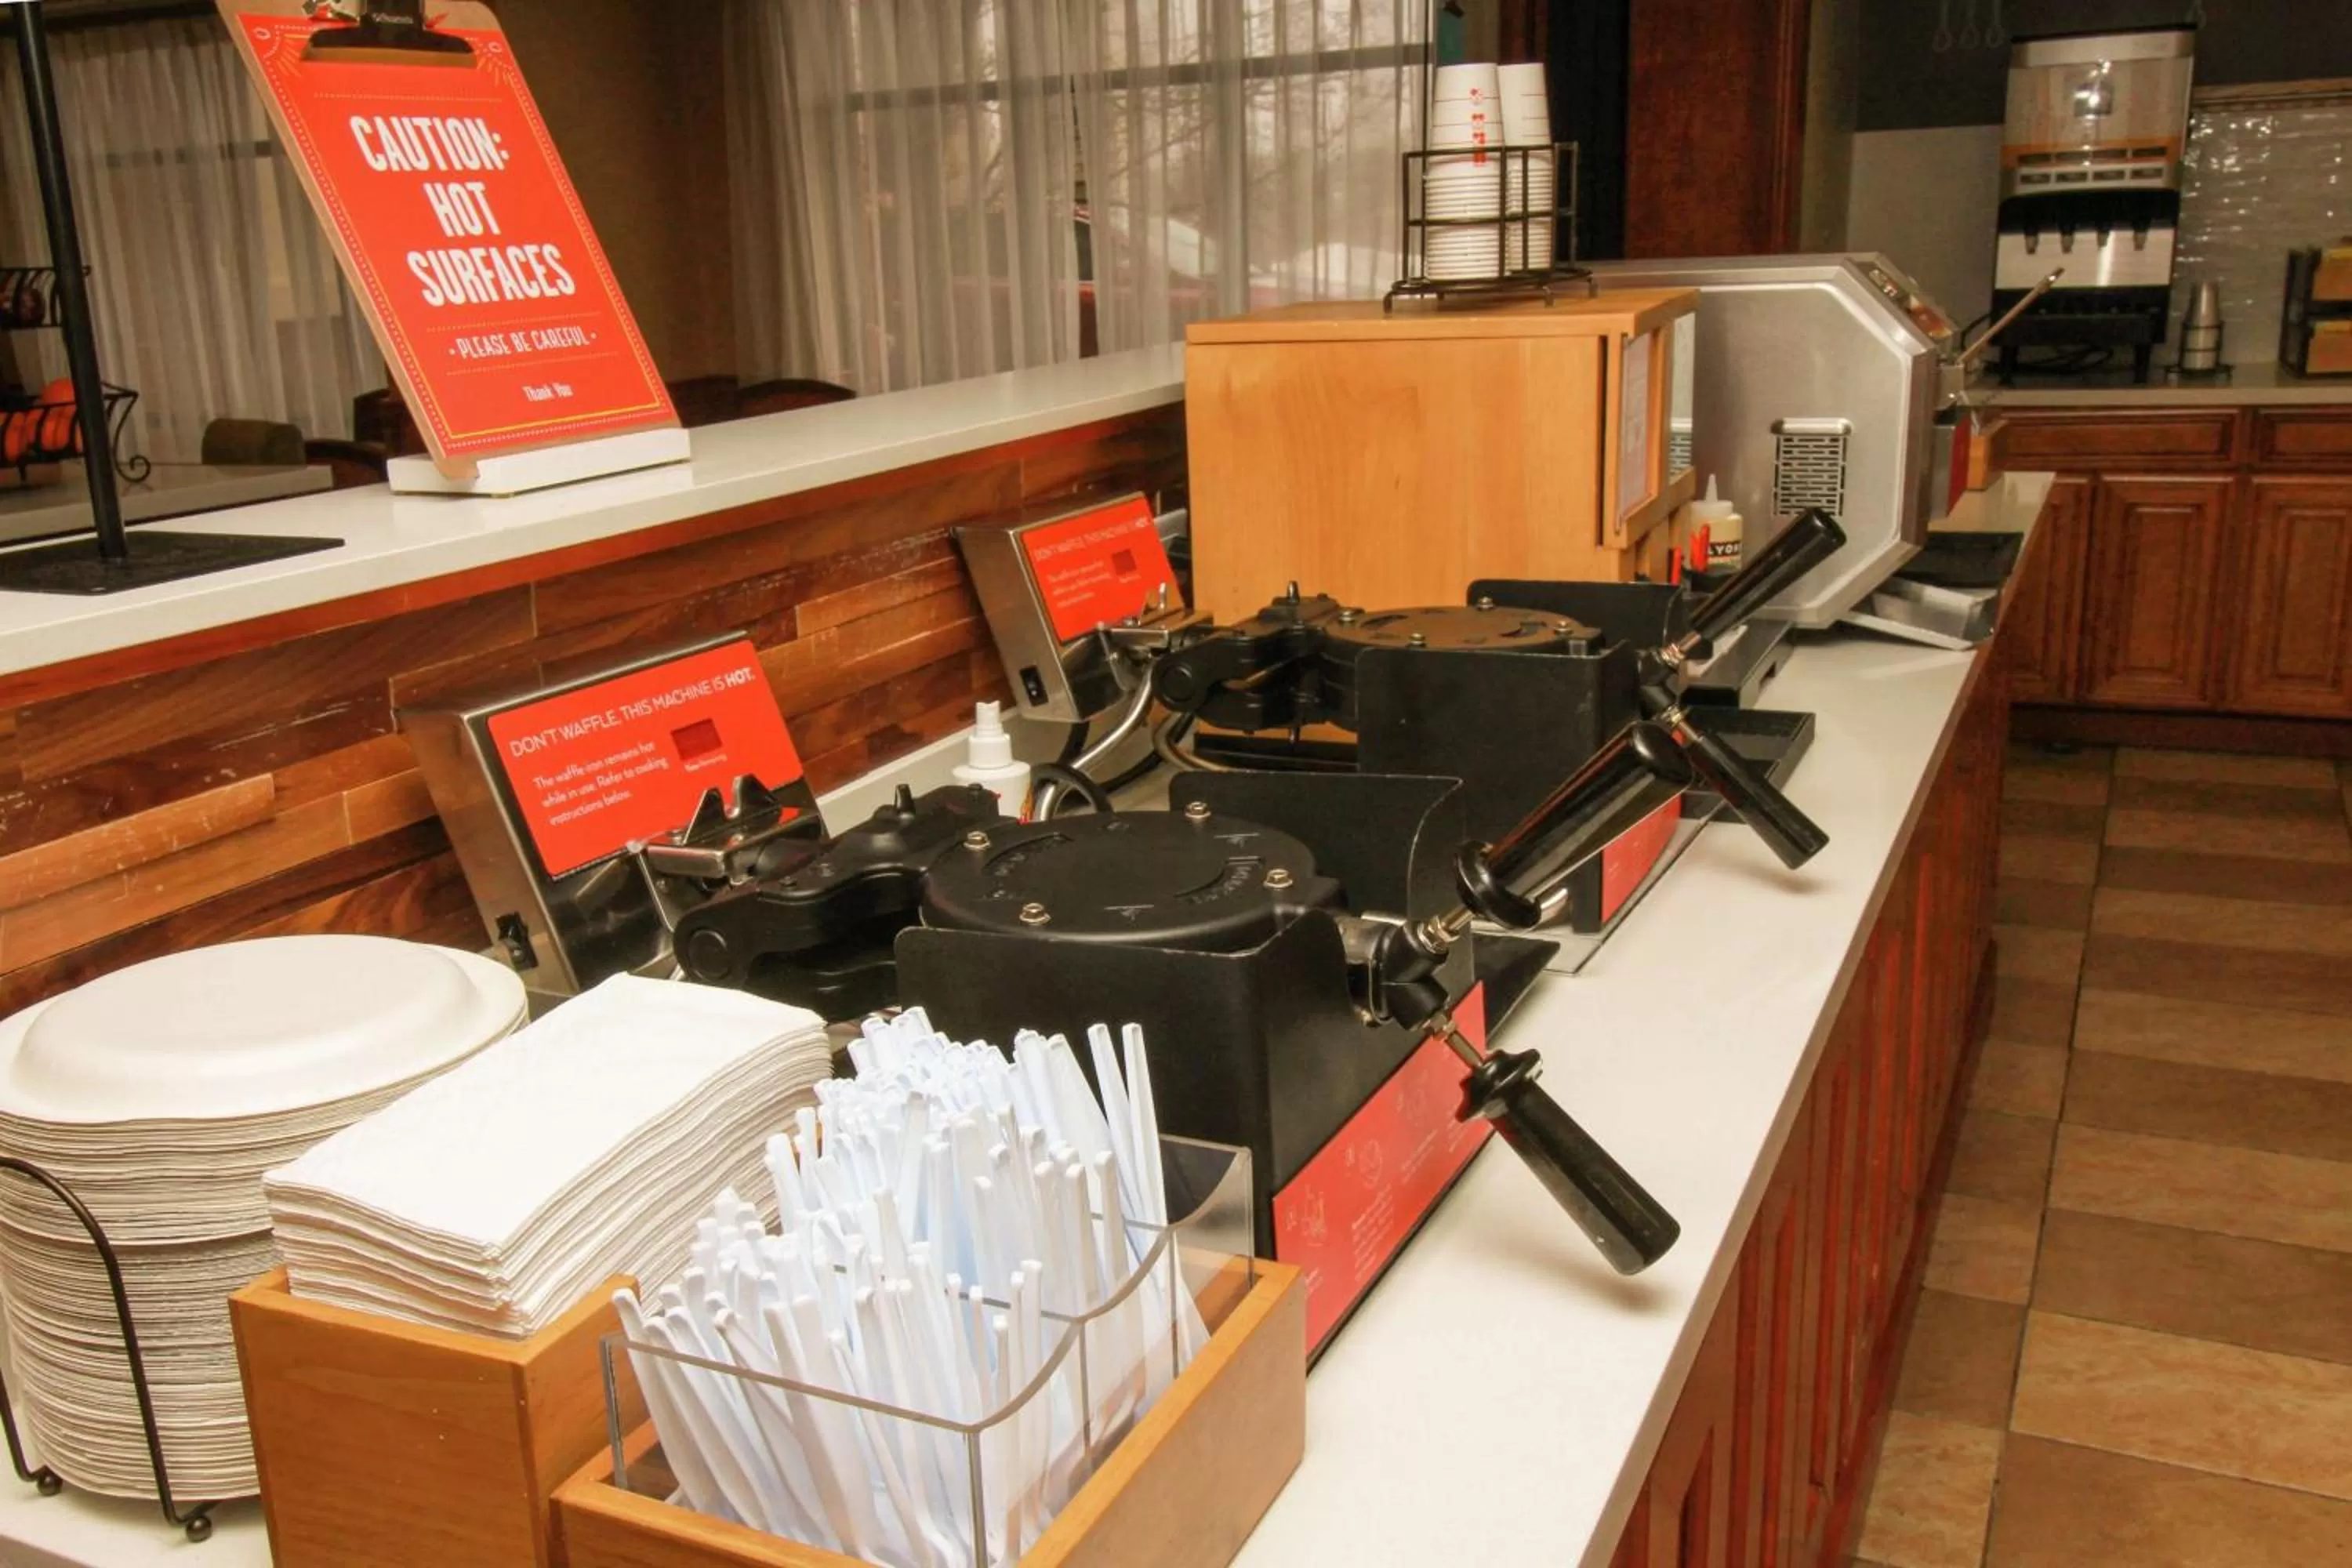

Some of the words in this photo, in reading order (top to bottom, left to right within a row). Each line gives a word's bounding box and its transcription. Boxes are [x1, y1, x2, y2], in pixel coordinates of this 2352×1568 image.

[350, 116, 509, 172] CAUTION:
[423, 182, 500, 237] HOT
[407, 244, 575, 307] SURFACES
[456, 334, 511, 359] PLEASE
[510, 332, 532, 352] BE
[531, 326, 590, 350] CAREFUL
[522, 384, 554, 401] Thank
[552, 383, 573, 397] You
[510, 728, 557, 757] DON'T
[620, 699, 652, 721] THIS
[652, 680, 711, 710] MACHINE
[713, 676, 725, 691] IS
